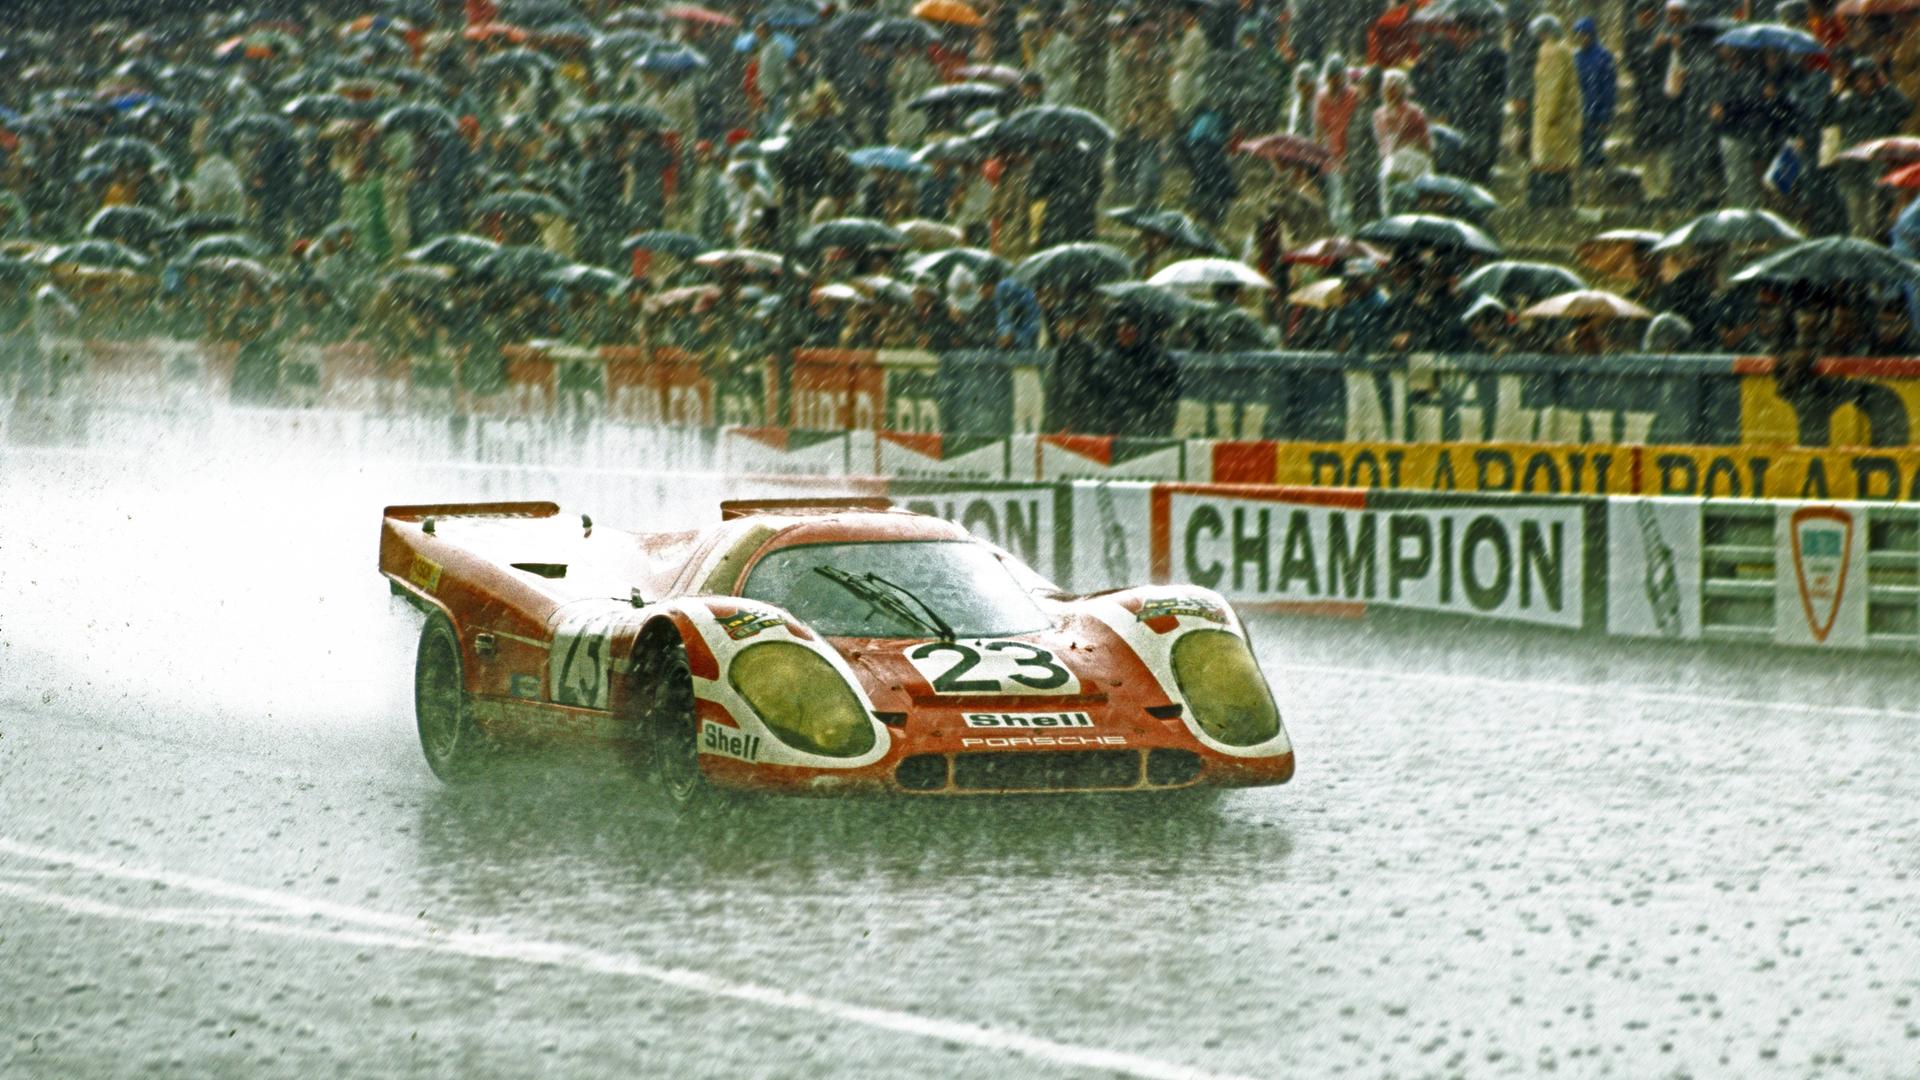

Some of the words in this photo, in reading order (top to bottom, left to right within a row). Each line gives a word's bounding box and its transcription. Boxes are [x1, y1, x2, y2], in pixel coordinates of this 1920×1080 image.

[1184, 504, 1564, 612] CHAMPION
[911, 641, 1070, 692] 23
[969, 713, 1089, 727] Shell
[704, 723, 760, 760] Shell
[961, 736, 1128, 747] PORSCHE
